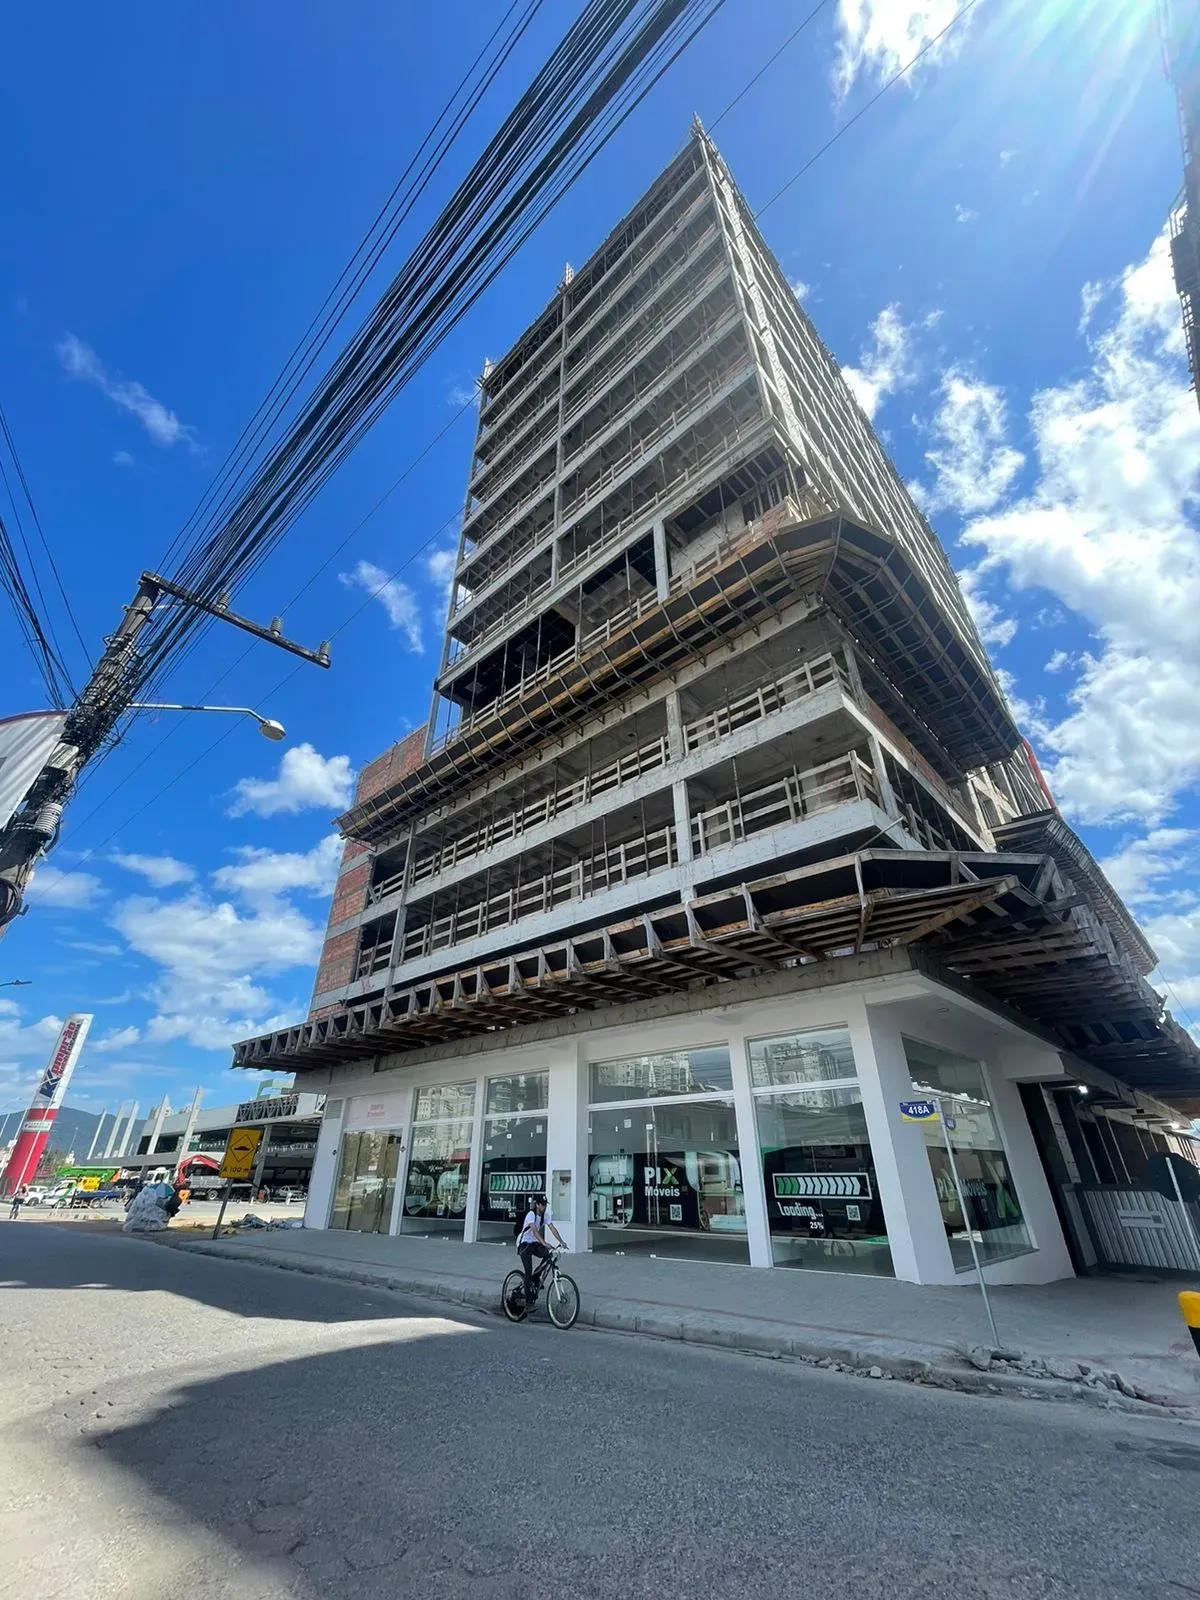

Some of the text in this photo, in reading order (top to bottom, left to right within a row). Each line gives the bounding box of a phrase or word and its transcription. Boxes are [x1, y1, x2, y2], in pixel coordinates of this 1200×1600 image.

[908, 1105, 930, 1115] 418A
[644, 1166, 680, 1185] PIX
[644, 1185, 681, 1197] Móveis
[777, 1201, 824, 1220] Loading...
[810, 1221, 824, 1230] 25%
